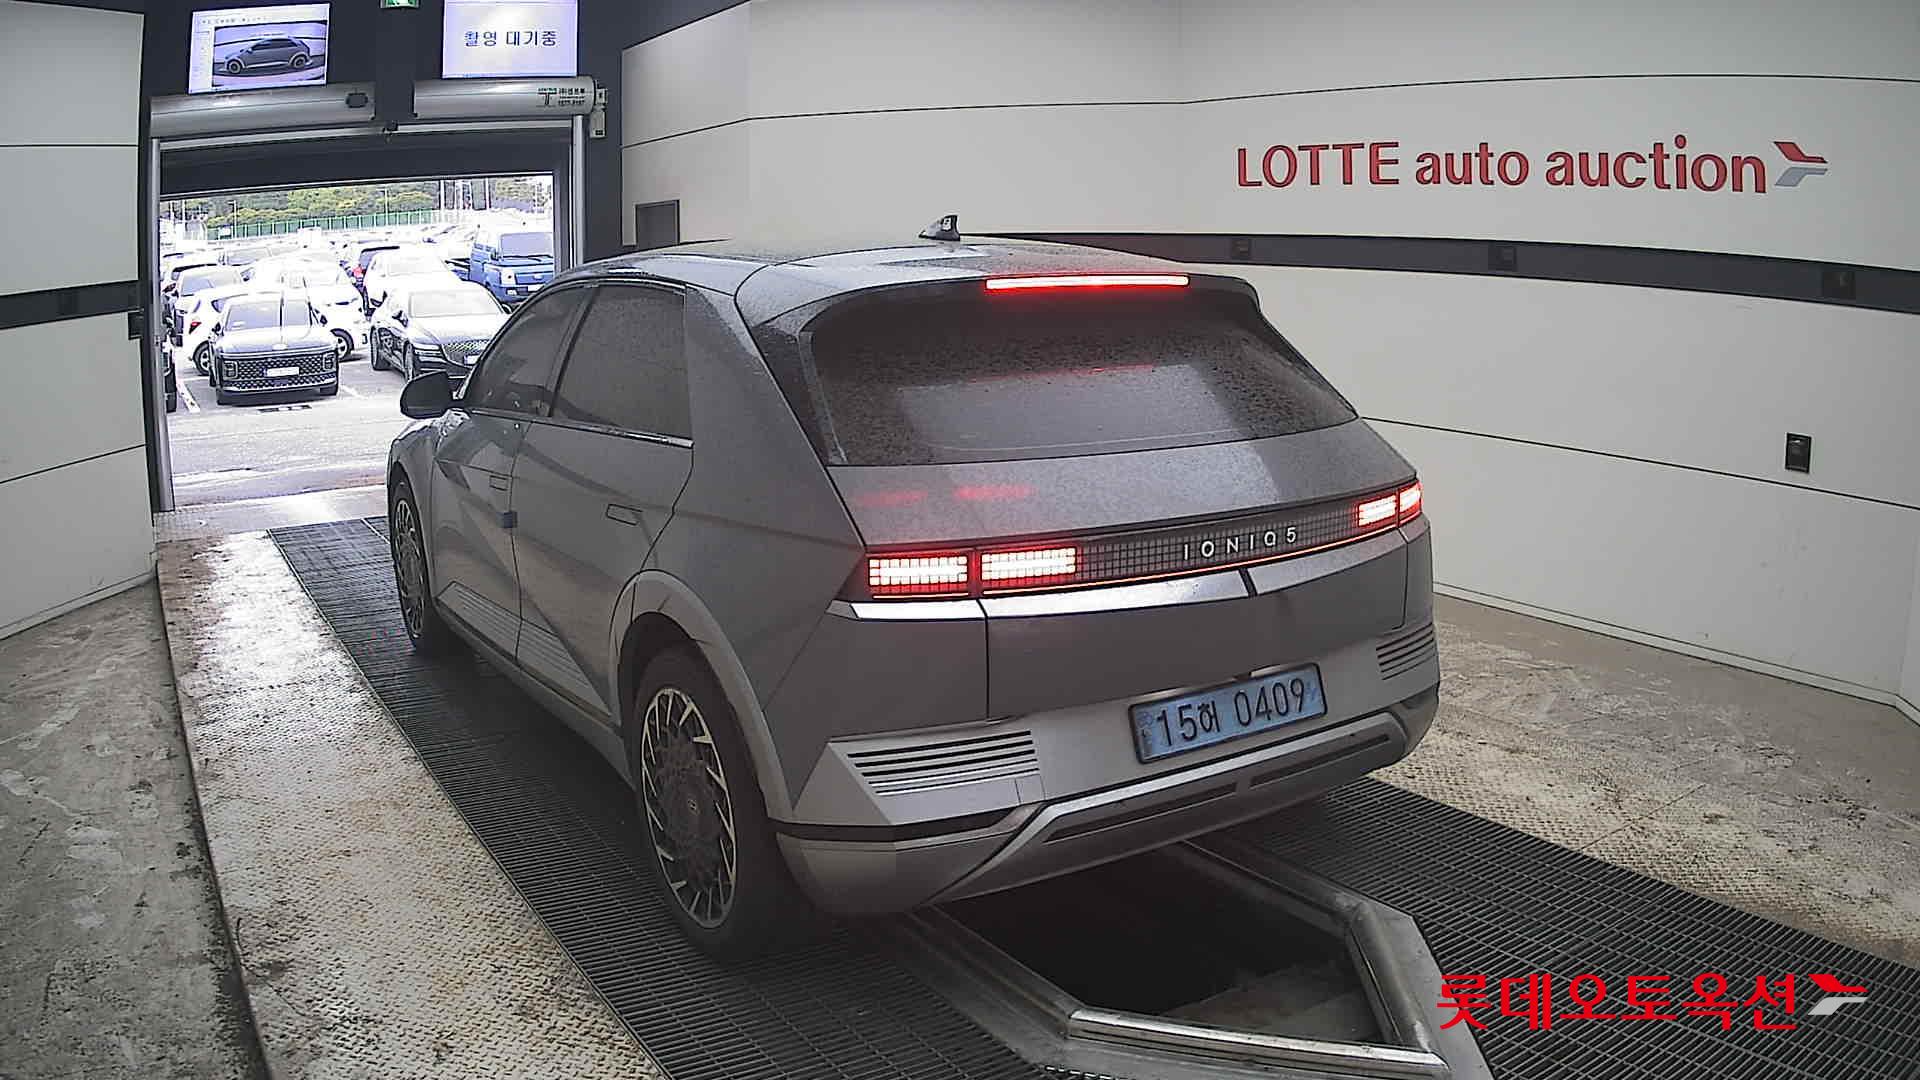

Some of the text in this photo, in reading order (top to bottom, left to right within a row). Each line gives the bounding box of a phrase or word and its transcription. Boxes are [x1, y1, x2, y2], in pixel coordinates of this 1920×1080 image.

[505, 30, 558, 47] 대기중
[1237, 134, 1768, 194] LOTTE auto auction
[1233, 677, 1306, 727] 0409
